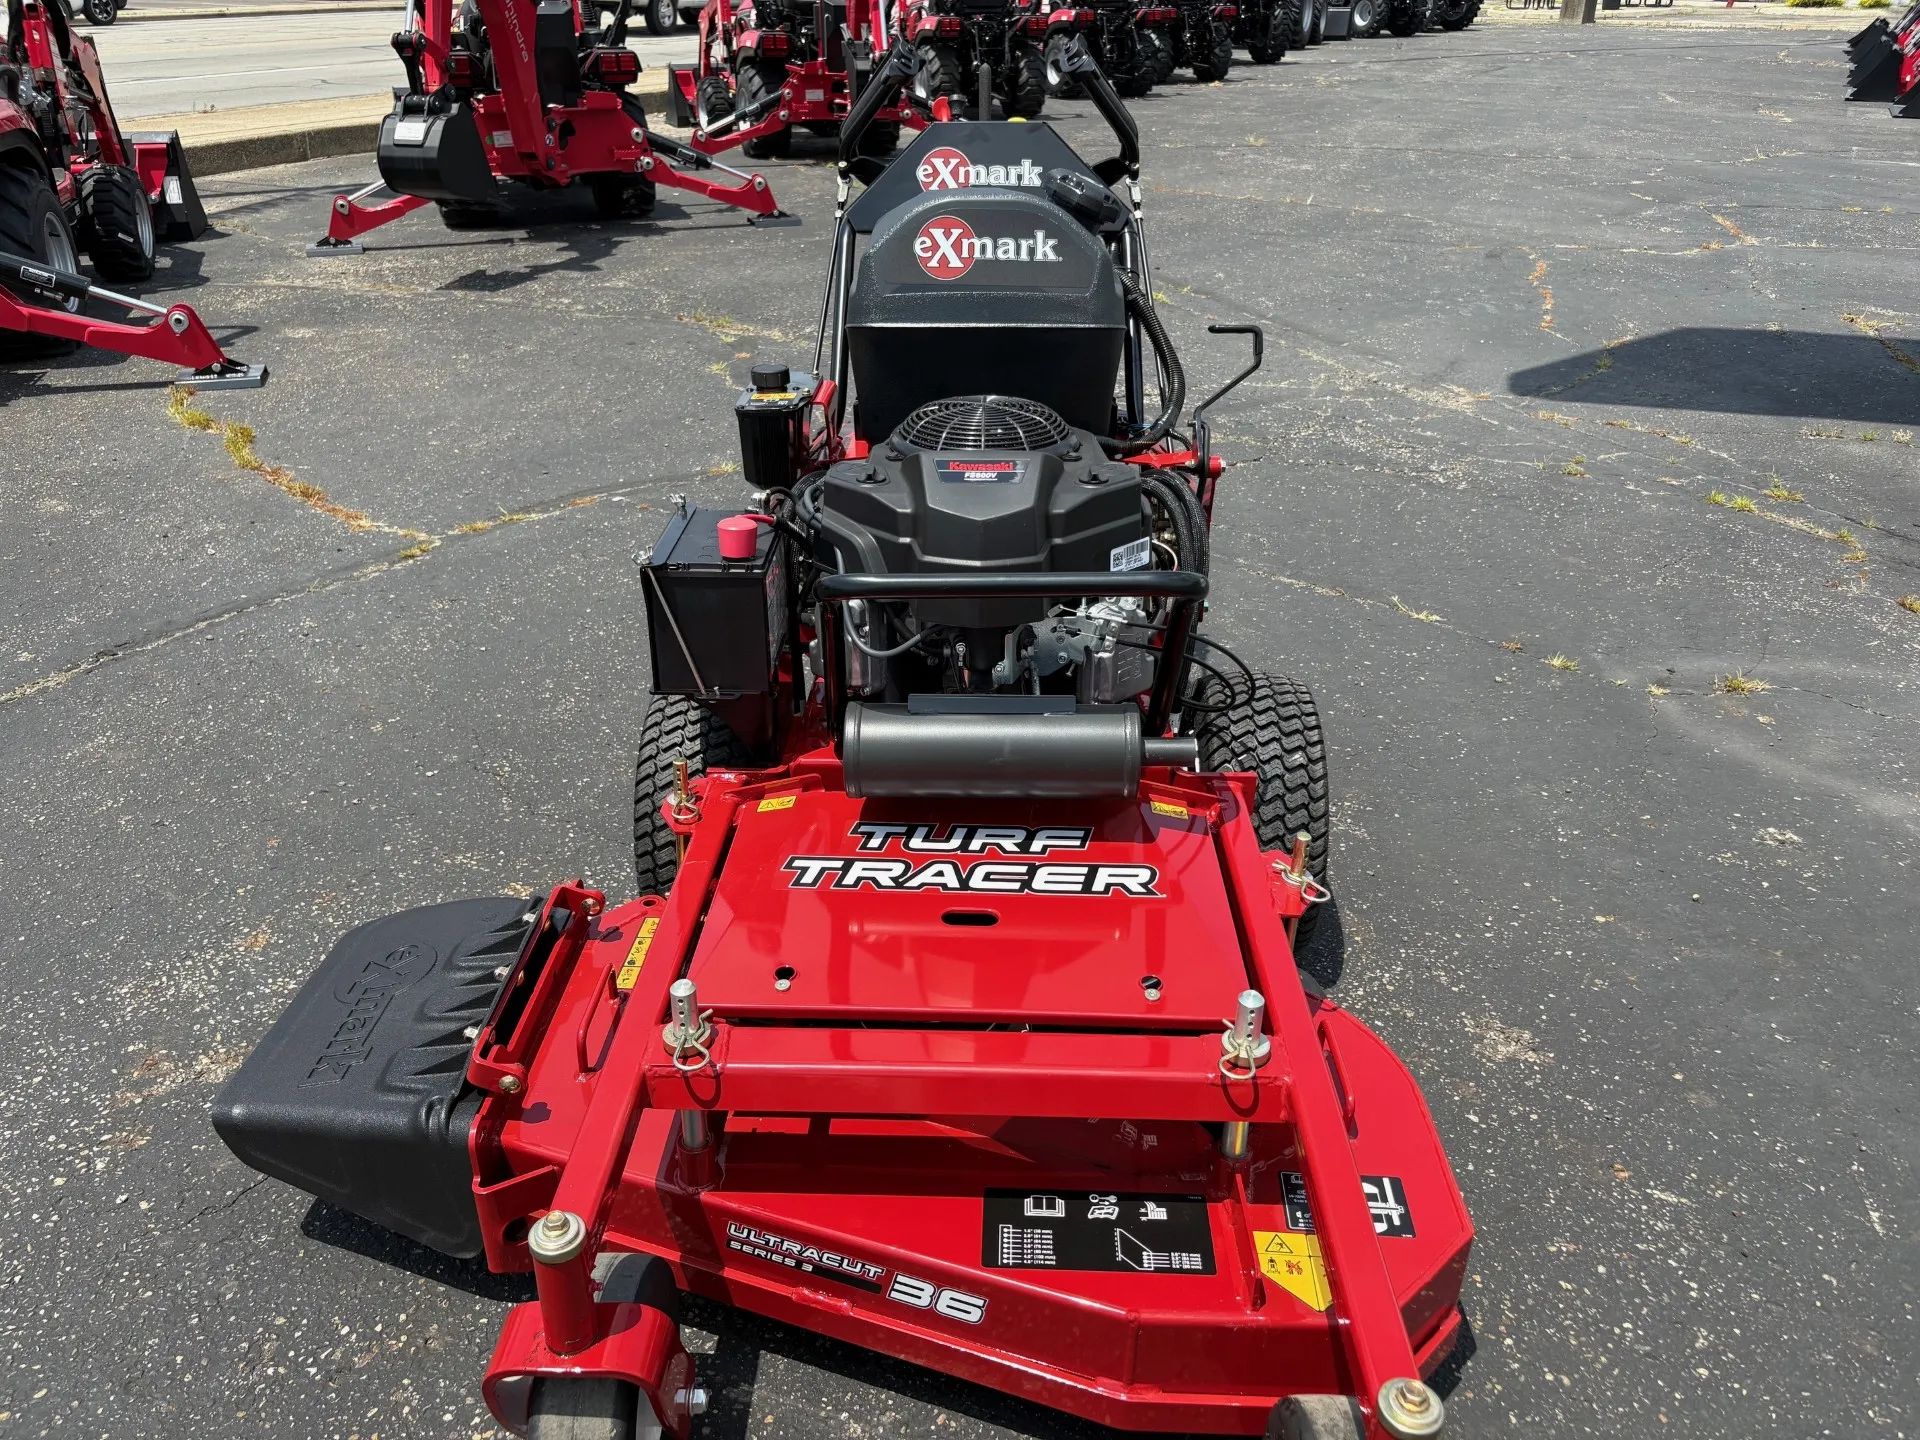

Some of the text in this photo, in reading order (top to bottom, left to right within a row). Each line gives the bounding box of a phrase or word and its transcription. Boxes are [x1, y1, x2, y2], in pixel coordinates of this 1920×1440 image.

[948, 461, 1014, 471] Kawasaki
[853, 823, 1090, 853] TURF
[783, 857, 1161, 895] TRACER
[729, 1222, 884, 1279] ULTRACUT
[729, 1240, 814, 1272] SERIES 3
[889, 1272, 987, 1322] 36
